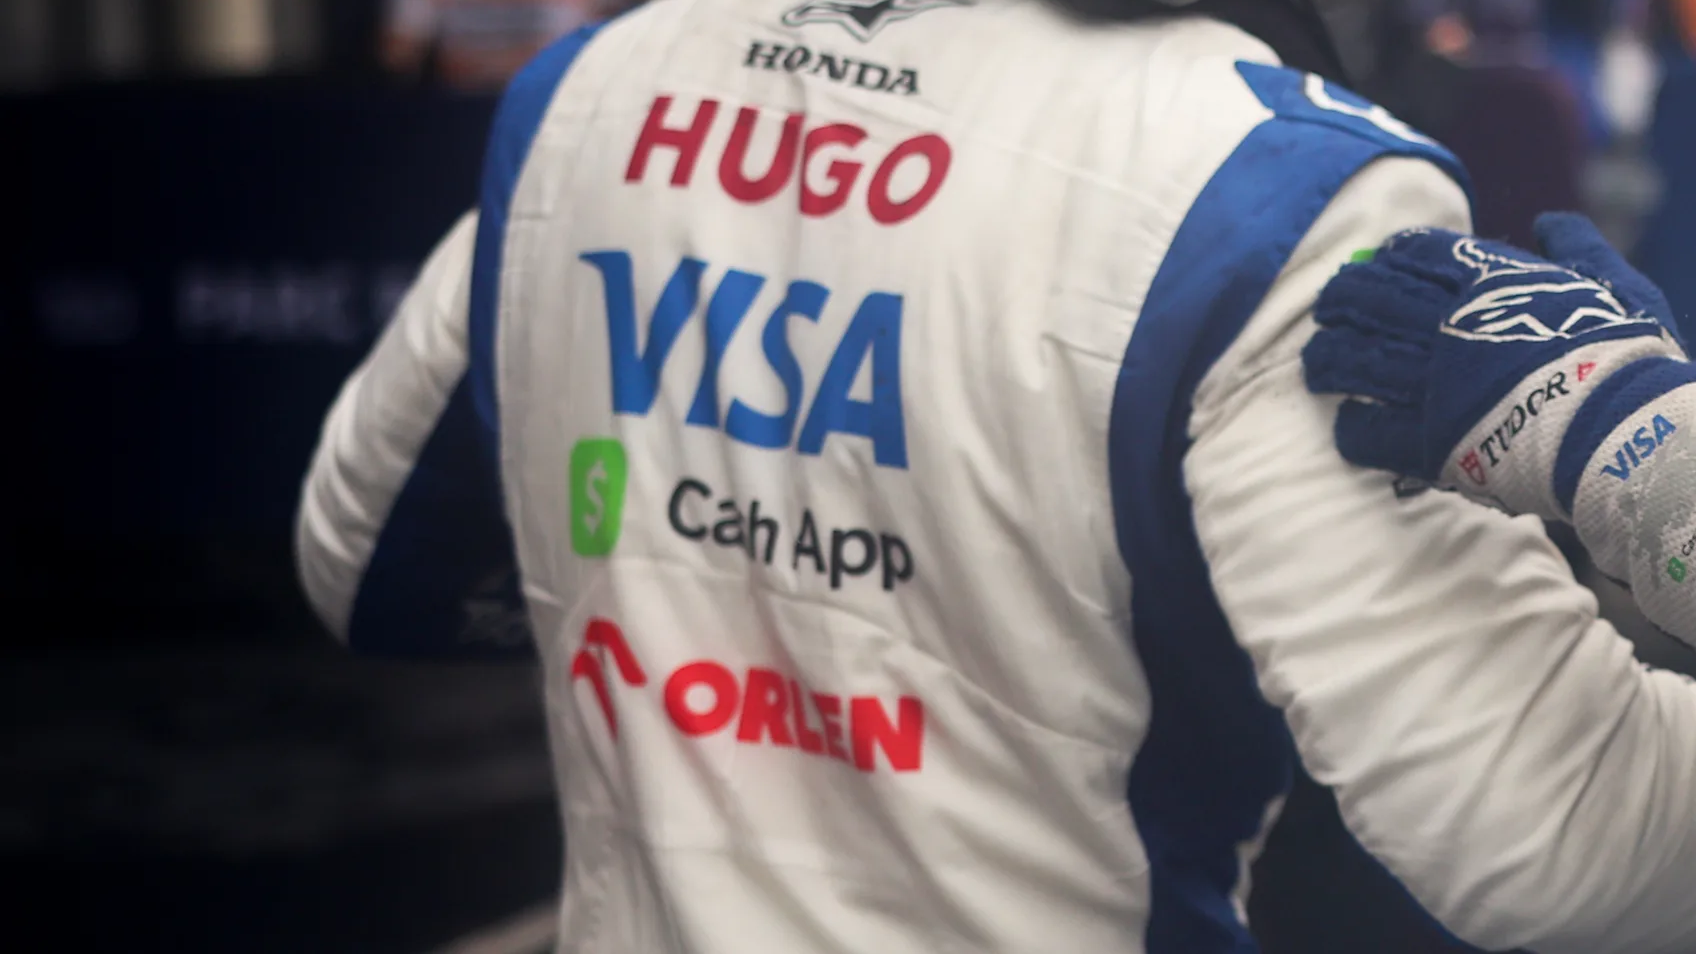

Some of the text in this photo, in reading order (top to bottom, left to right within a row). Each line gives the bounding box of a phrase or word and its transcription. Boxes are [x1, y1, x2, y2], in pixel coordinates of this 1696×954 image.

[742, 43, 920, 96] HONDA
[624, 94, 952, 225] HUGO
[578, 250, 909, 470] VISA
[1480, 371, 1570, 467] TUDOR
[1601, 414, 1677, 481] VISA
[792, 507, 915, 591] App
[662, 659, 925, 774] ORLEN
